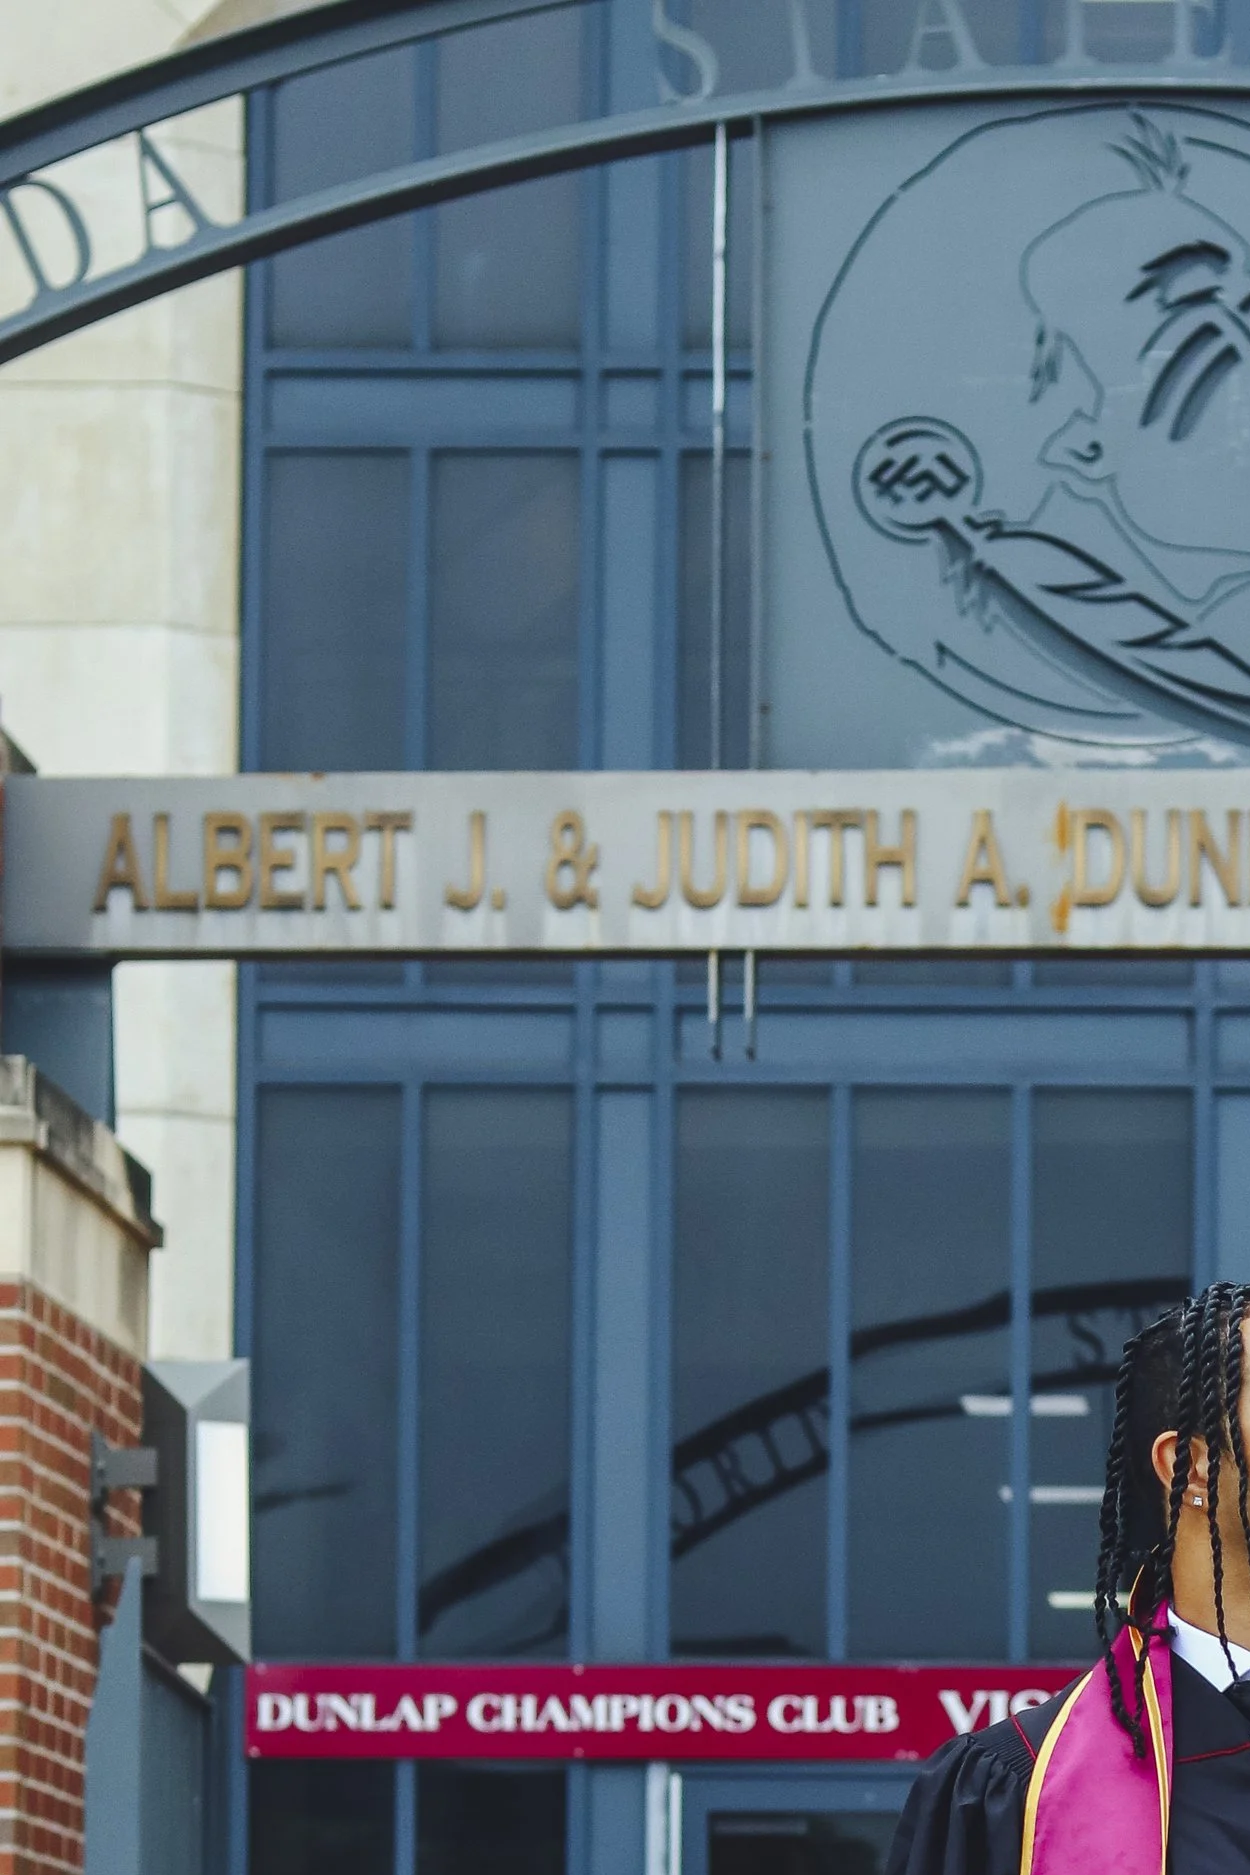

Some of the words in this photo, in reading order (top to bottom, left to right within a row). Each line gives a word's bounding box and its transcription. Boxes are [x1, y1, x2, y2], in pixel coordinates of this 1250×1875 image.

[91, 809, 413, 912] ALBERT
[444, 809, 505, 911] J.
[545, 809, 600, 910] &
[632, 807, 918, 910] JUDITH
[955, 807, 1031, 908] A.
[255, 1692, 458, 1733] DUNLAP
[465, 1692, 757, 1734] CHAMPIONS
[767, 1693, 900, 1734] CLUB
